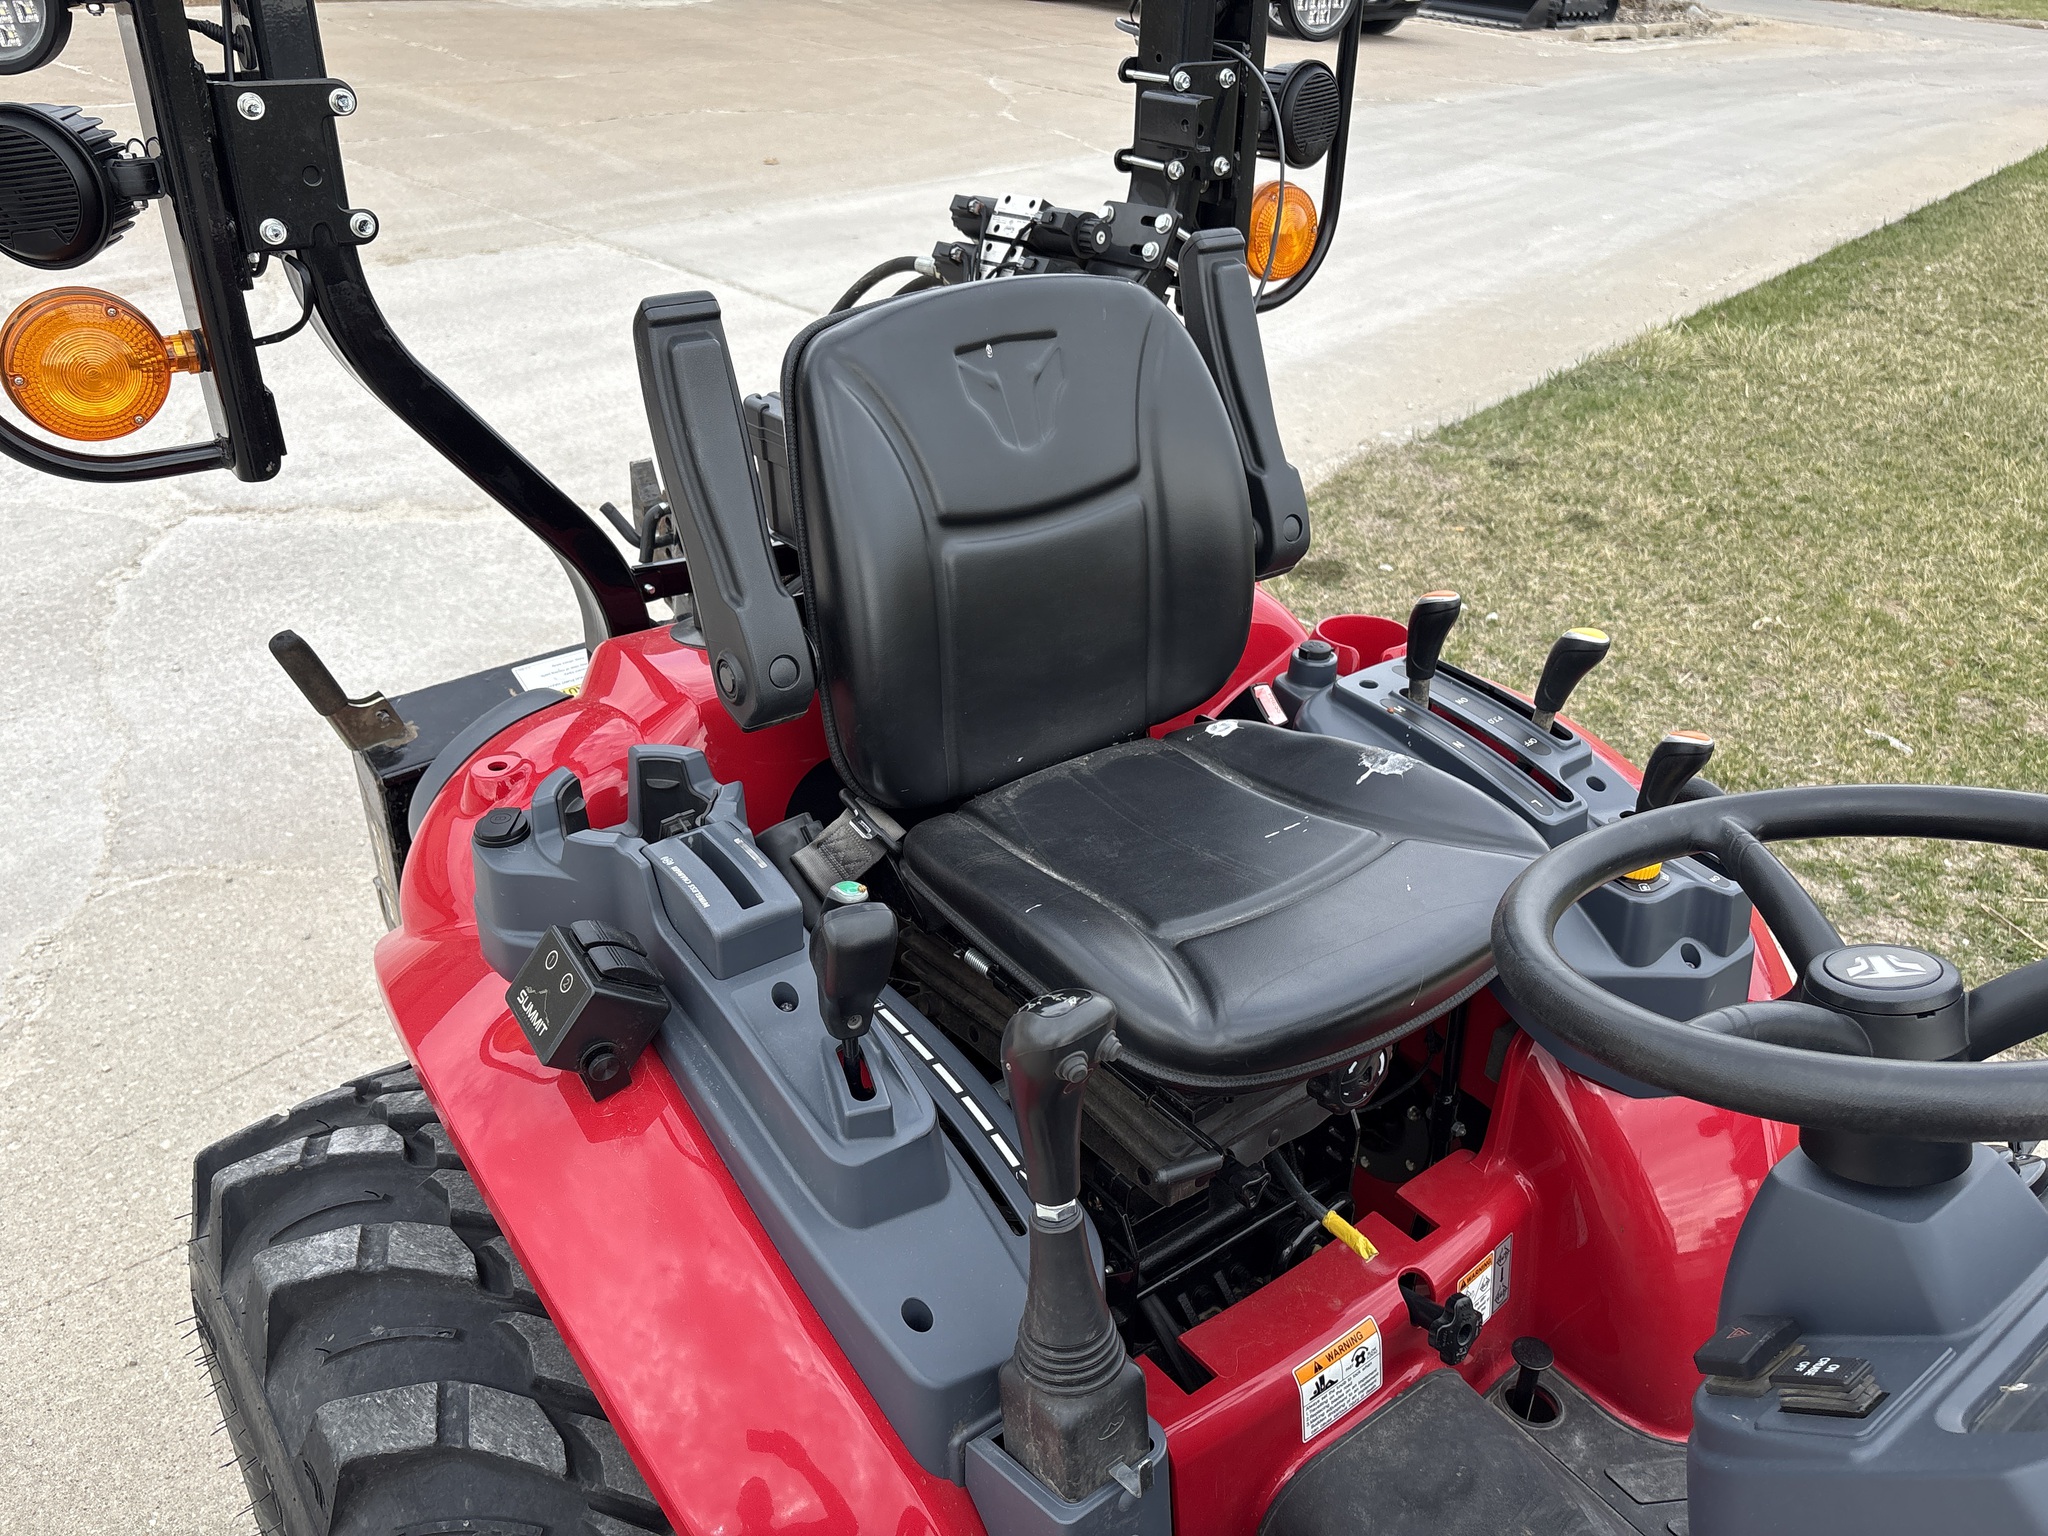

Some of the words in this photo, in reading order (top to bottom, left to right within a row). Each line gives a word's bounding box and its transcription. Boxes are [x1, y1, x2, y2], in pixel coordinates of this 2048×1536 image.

[1452, 740, 1466, 749] N
[1524, 737, 1538, 746] OFF
[1531, 800, 1544, 808] L
[671, 866, 692, 884] CHARGER
[687, 884, 710, 908] WIRELESS
[516, 989, 548, 1036] SUMMIT
[1466, 1258, 1492, 1283] WARNING
[1326, 1331, 1364, 1362] WARNING
[1794, 1361, 1810, 1372] OFF
[1803, 1357, 1831, 1376] CRUISE
[1824, 1364, 1840, 1372] ON
[1343, 1380, 1352, 1390] road
[1358, 1367, 1376, 1385] implement
[1305, 1398, 1319, 1411] Always
[1336, 1379, 1346, 1389] knob
[1362, 1361, 1372, 1371] when
